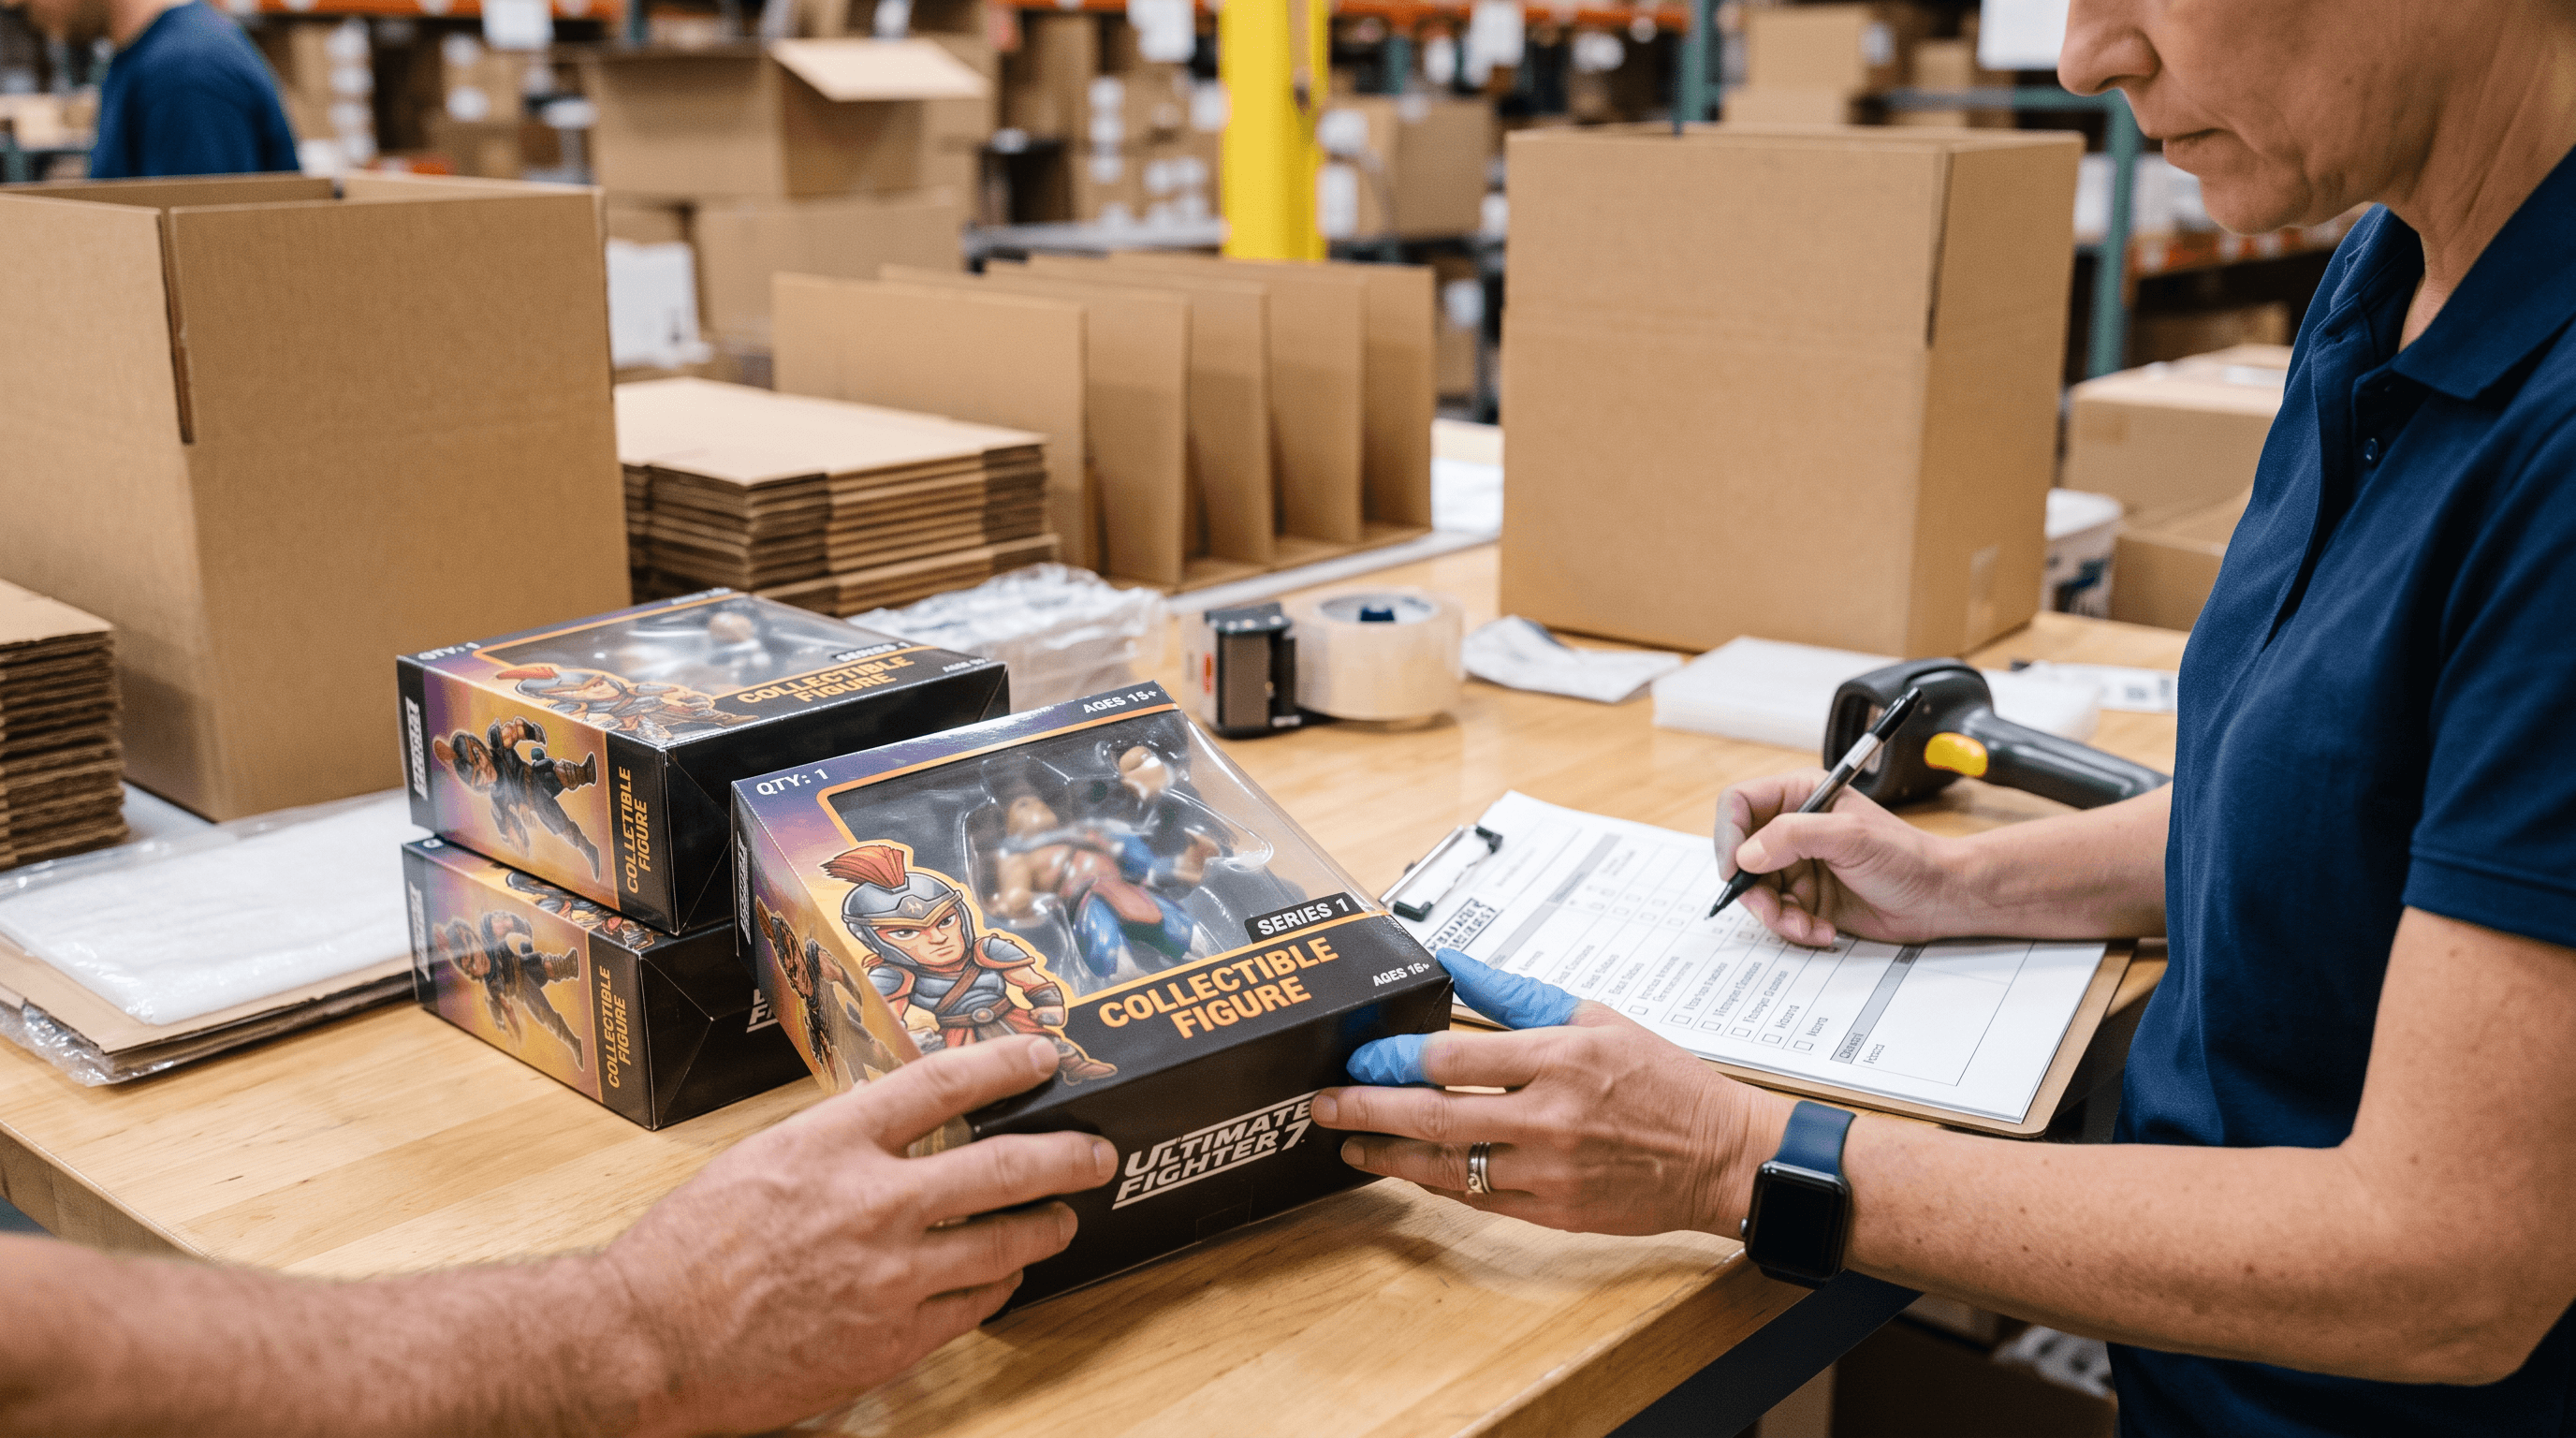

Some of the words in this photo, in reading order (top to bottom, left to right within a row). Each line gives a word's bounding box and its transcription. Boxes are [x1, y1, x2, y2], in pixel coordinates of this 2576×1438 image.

[737, 655, 915, 703] COLLECTIBLE
[793, 672, 897, 703] FIGURE
[1082, 697, 1127, 713] AGES
[755, 773, 812, 796] QTY:
[814, 768, 829, 780] 1
[618, 766, 639, 894] COLLETIBLE
[634, 799, 651, 872] FIGURE
[1257, 903, 1333, 936] SERIES
[1336, 898, 1350, 913] 1
[1098, 936, 1339, 1029] COLLECTIBLE
[1170, 976, 1312, 1039] FIGURE
[1372, 967, 1408, 987] AGES
[599, 965, 621, 1089] COLLECTIBLE
[614, 994, 632, 1066] FIGURE
[1114, 1130, 1281, 1203] FIGHTER
[1124, 1099, 1312, 1178] ULTIMATE
